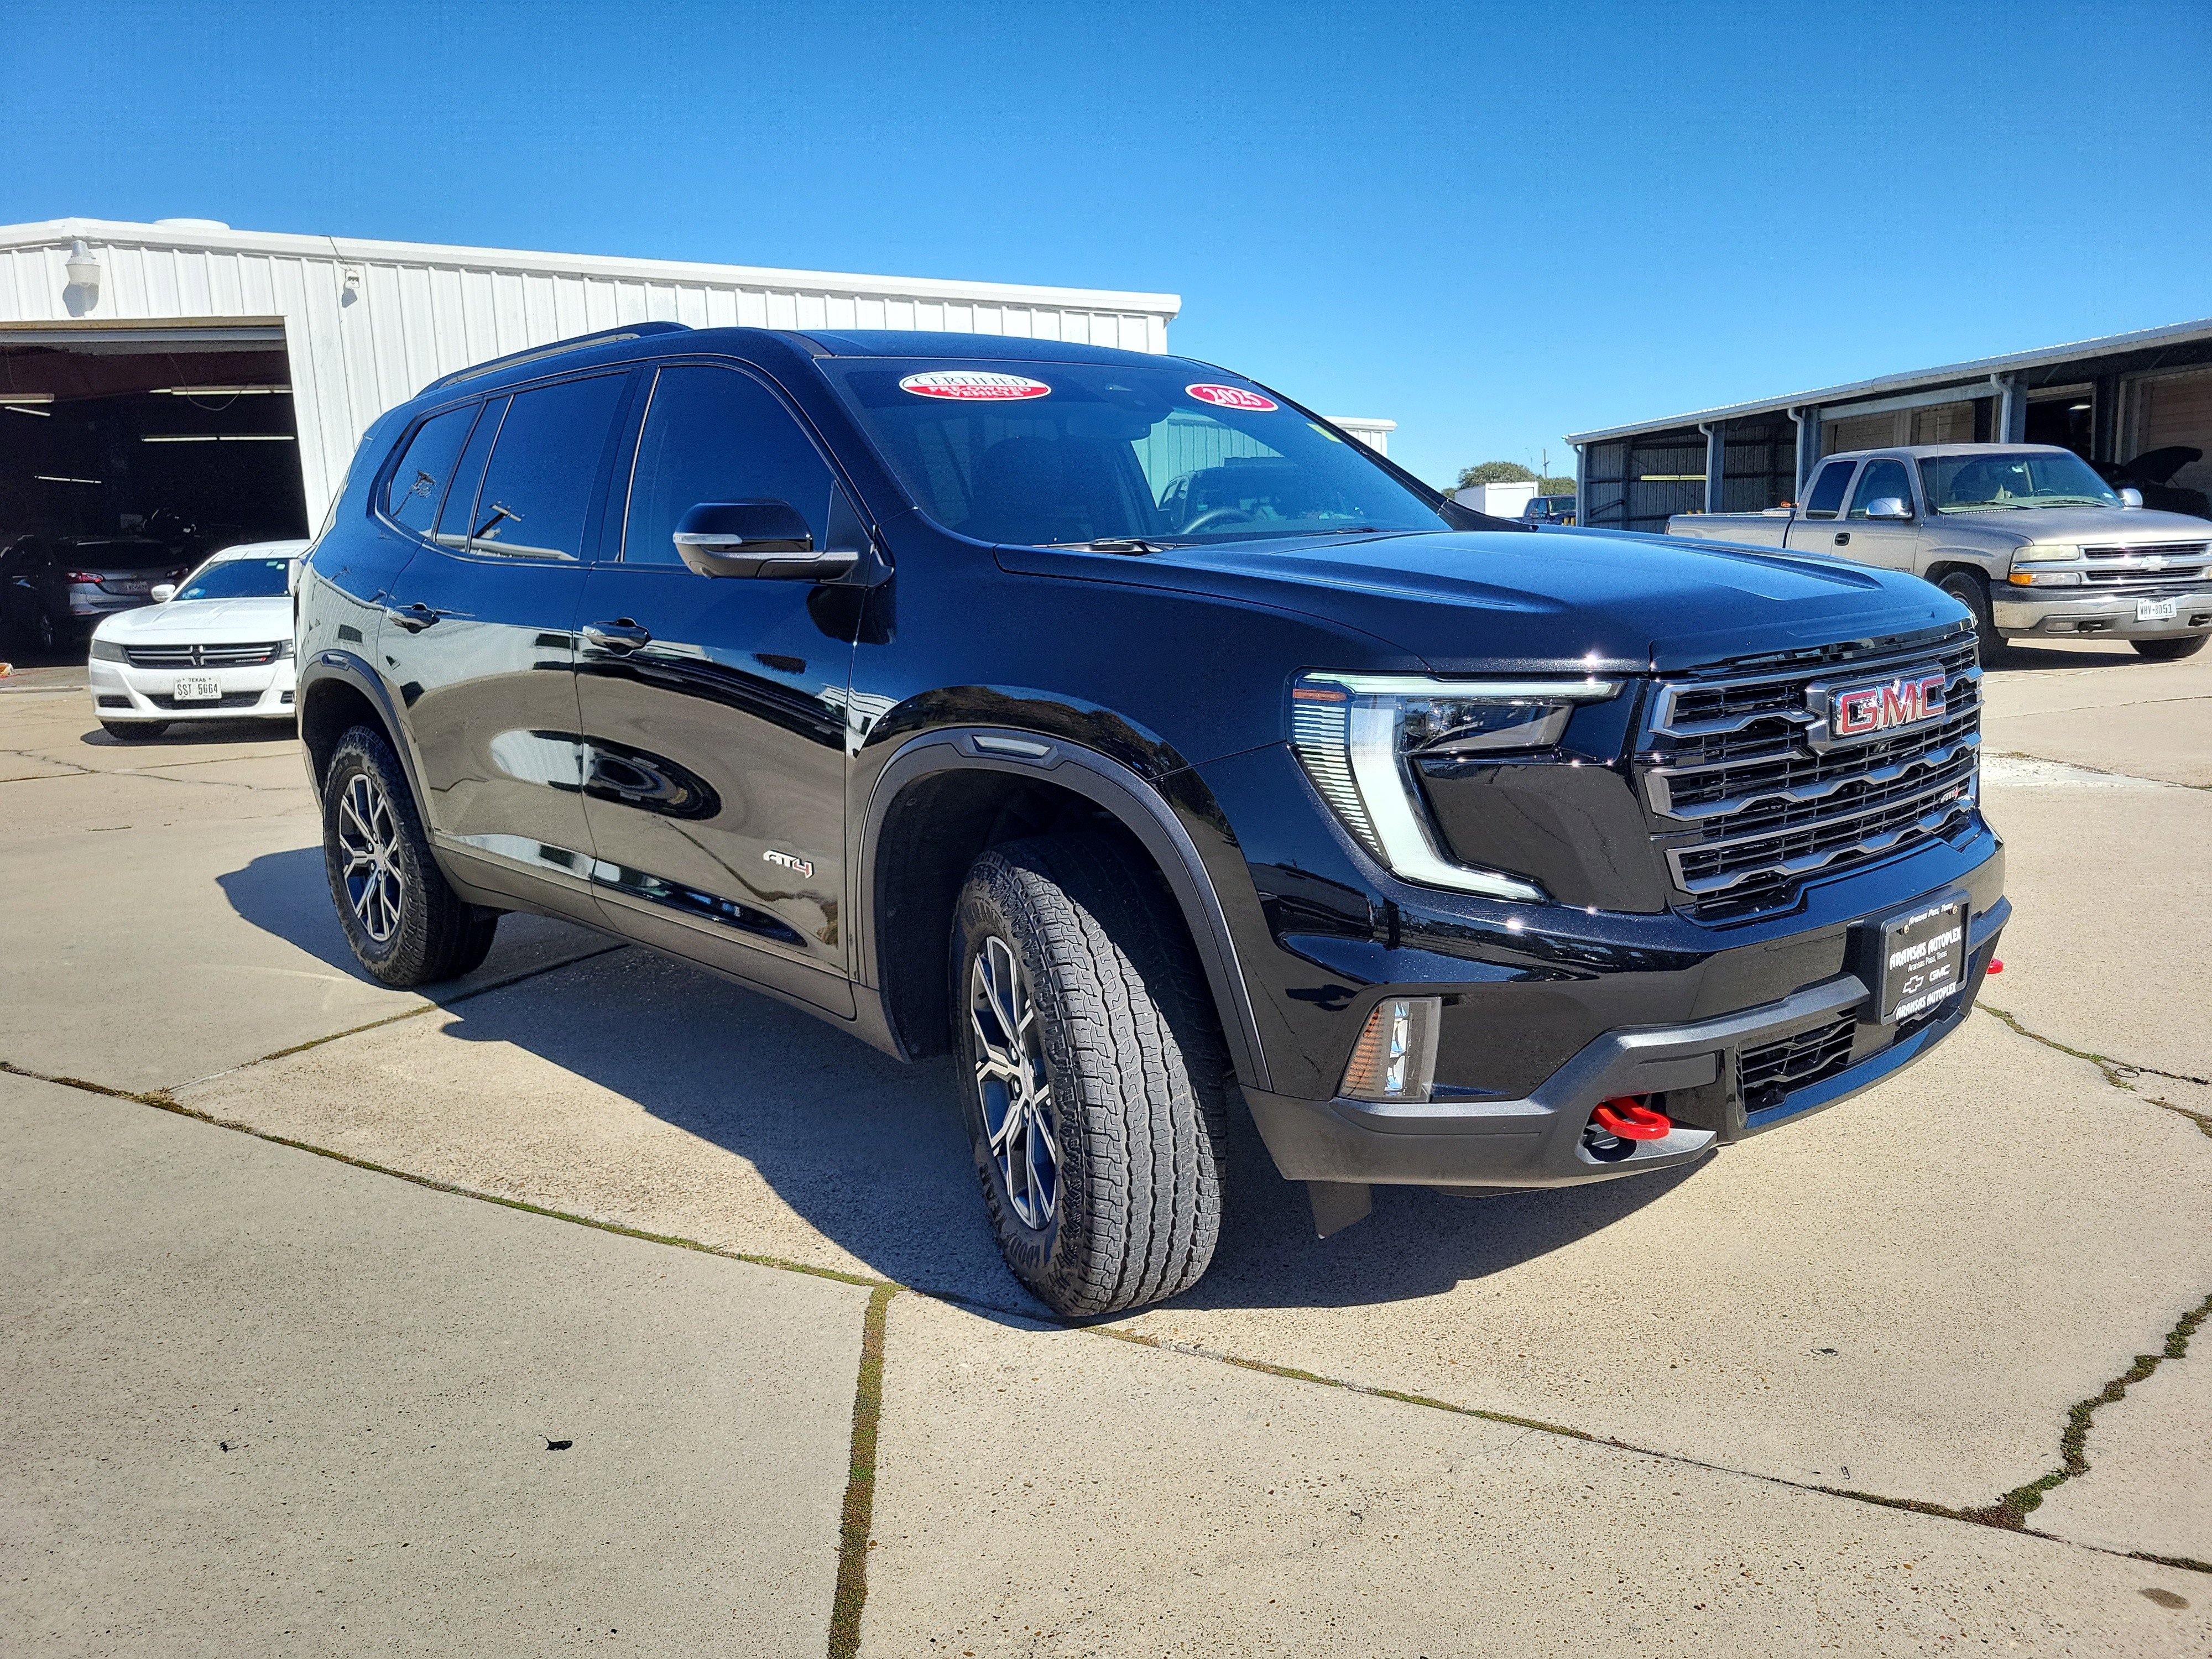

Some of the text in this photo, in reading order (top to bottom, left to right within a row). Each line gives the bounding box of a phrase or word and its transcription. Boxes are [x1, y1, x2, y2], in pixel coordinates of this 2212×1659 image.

[914, 377, 1028, 385] CERTIFIED
[1202, 388, 1262, 406] 2025
[197, 684, 218, 695] 5664
[1836, 673, 1945, 734] GMC
[763, 849, 814, 879] AT4
[1890, 926, 1961, 971] ARANSAS AUTOPLEX
[1908, 960, 1925, 973] Aransas
[1937, 950, 1948, 961] Texas
[1929, 963, 1951, 982] GMC
[1896, 981, 1957, 1020] ARANSAS AUTOPLEX
